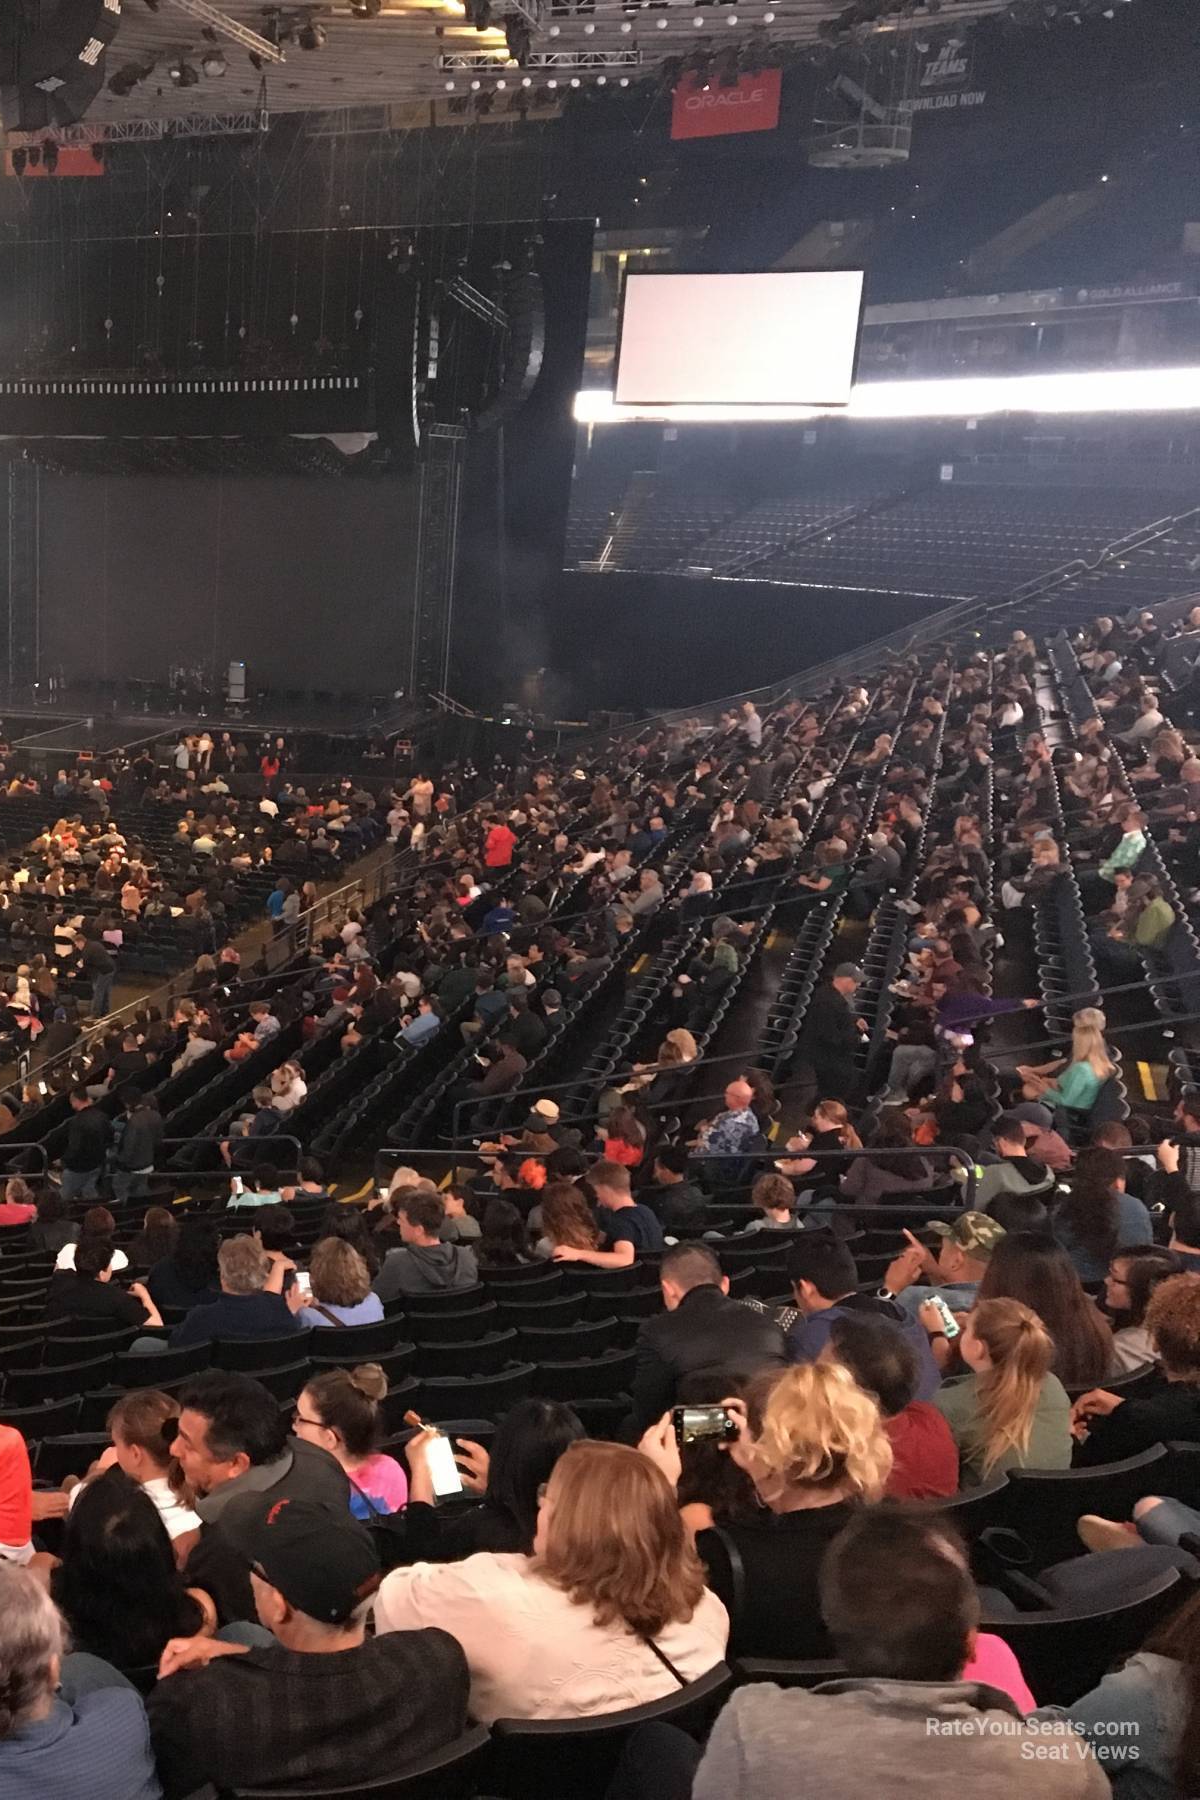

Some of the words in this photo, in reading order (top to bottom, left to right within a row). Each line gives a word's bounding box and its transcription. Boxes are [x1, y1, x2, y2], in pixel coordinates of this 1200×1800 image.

[79, 37, 105, 66] JBL
[923, 58, 968, 76] TEAMS
[685, 88, 767, 110] ORACLE
[960, 91, 987, 106] NOW
